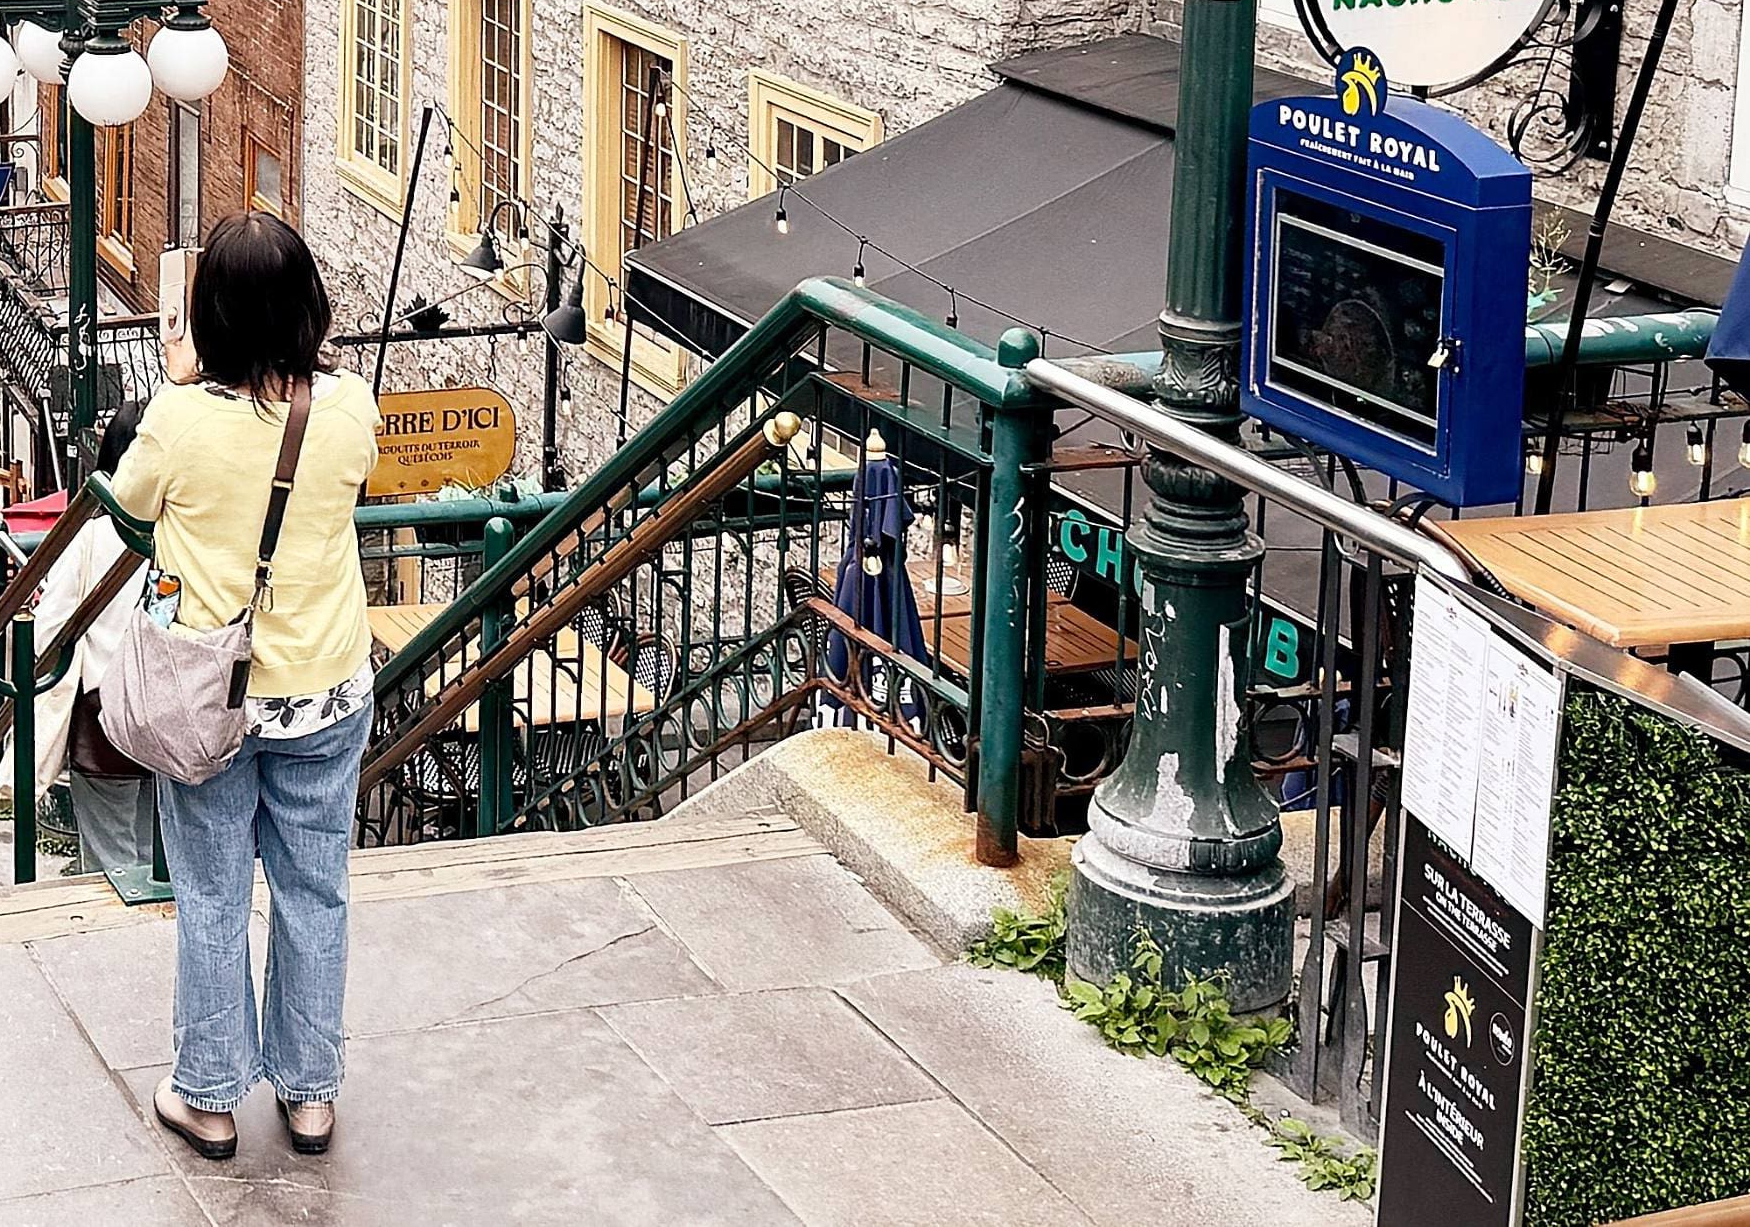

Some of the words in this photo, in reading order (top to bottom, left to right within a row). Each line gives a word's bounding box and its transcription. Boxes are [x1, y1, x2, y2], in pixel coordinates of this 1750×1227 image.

[1279, 105, 1360, 147] POULET
[1369, 132, 1440, 172] ROYAL
[375, 411, 435, 436] ERRE
[442, 406, 500, 430] D'ICI
[1423, 863, 1444, 892] SUR
[1445, 881, 1459, 905] LA
[1459, 892, 1511, 950] TERRASSE
[1435, 892, 1448, 910] ON
[1447, 901, 1462, 922] THE
[1462, 912, 1498, 953] TERRASSE
[1415, 1022, 1458, 1072] POULET
[1460, 1065, 1496, 1111] ROYAL
[1418, 1069, 1427, 1093] À
[1427, 1082, 1485, 1151] L'INTÉRIEUR
[1436, 1108, 1465, 1146] INSIDE
